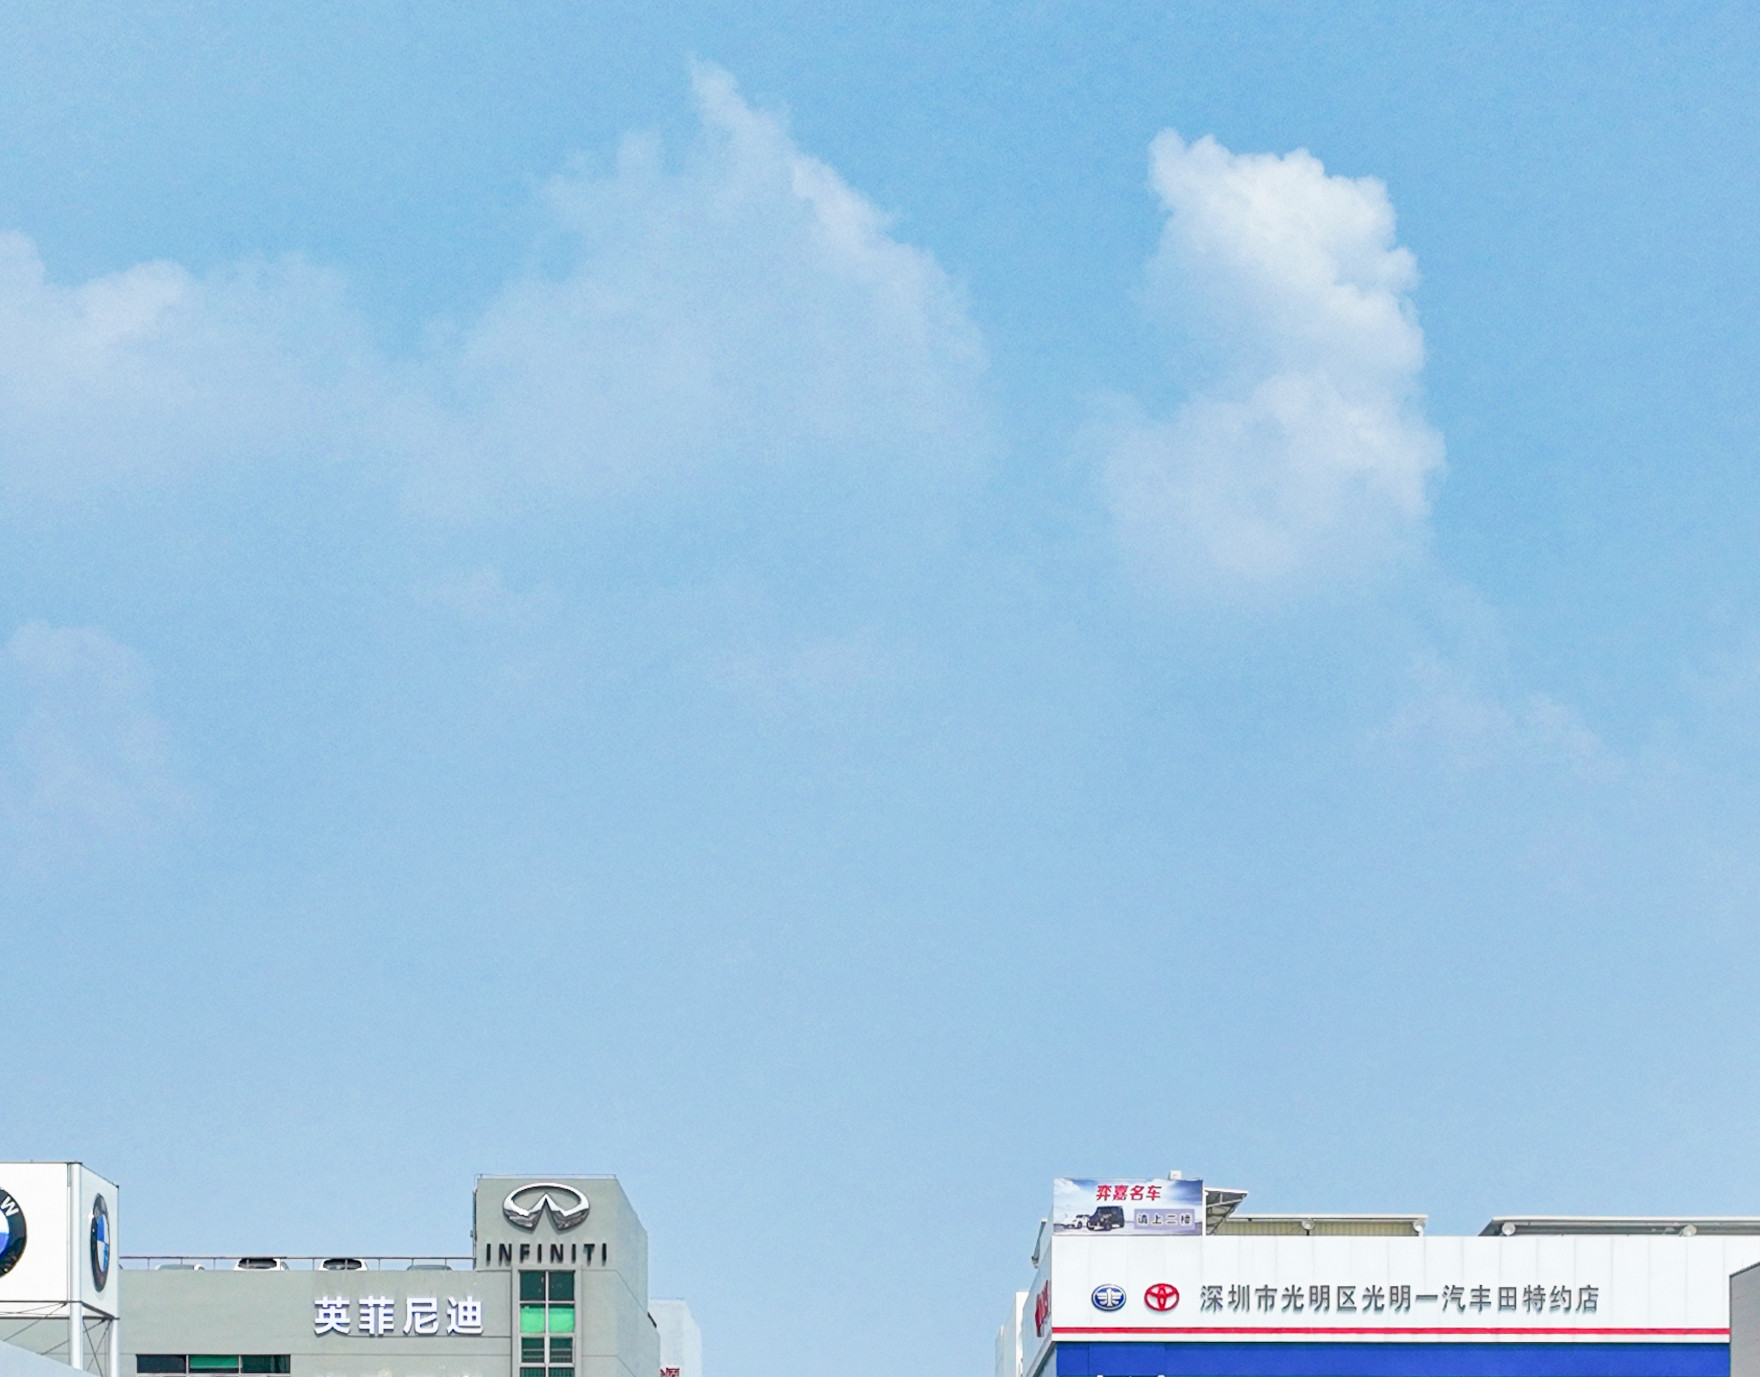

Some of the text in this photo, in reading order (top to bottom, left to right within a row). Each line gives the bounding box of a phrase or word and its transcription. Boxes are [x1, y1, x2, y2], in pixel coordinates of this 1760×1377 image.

[486, 1243, 607, 1265] INFINITI
[1200, 1284, 1599, 1313] 深圳市光明区光明一汽丰田特约店
[314, 1296, 484, 1336] 英菲尼迪
